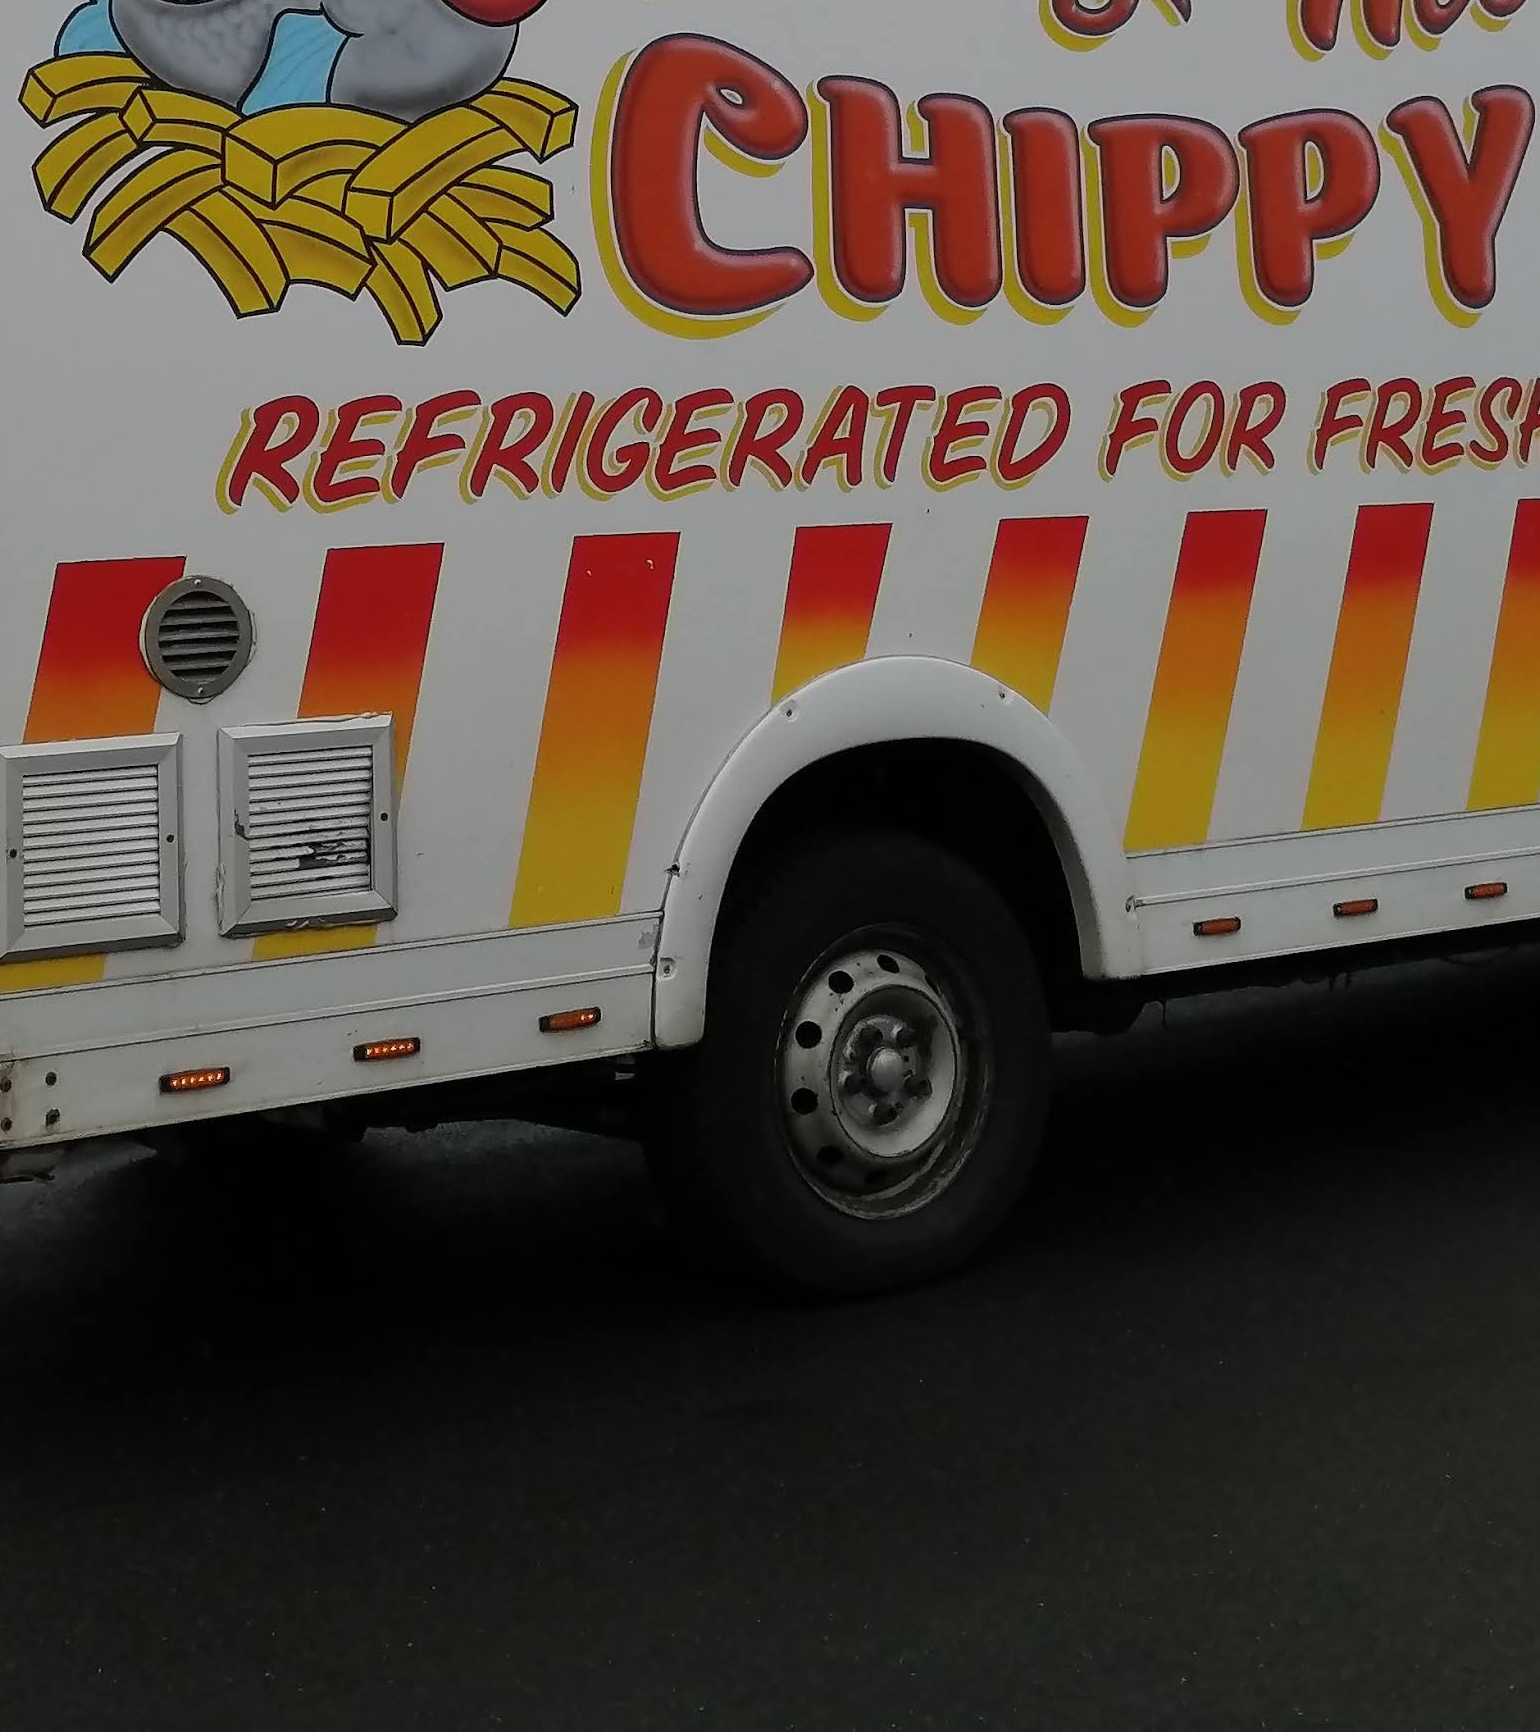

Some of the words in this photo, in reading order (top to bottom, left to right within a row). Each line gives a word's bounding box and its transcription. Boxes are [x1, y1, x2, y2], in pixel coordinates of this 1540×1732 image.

[591, 32, 1537, 341] CHIPPY
[215, 378, 1071, 515] REFRIGERATED
[1098, 378, 1287, 483] FOR
